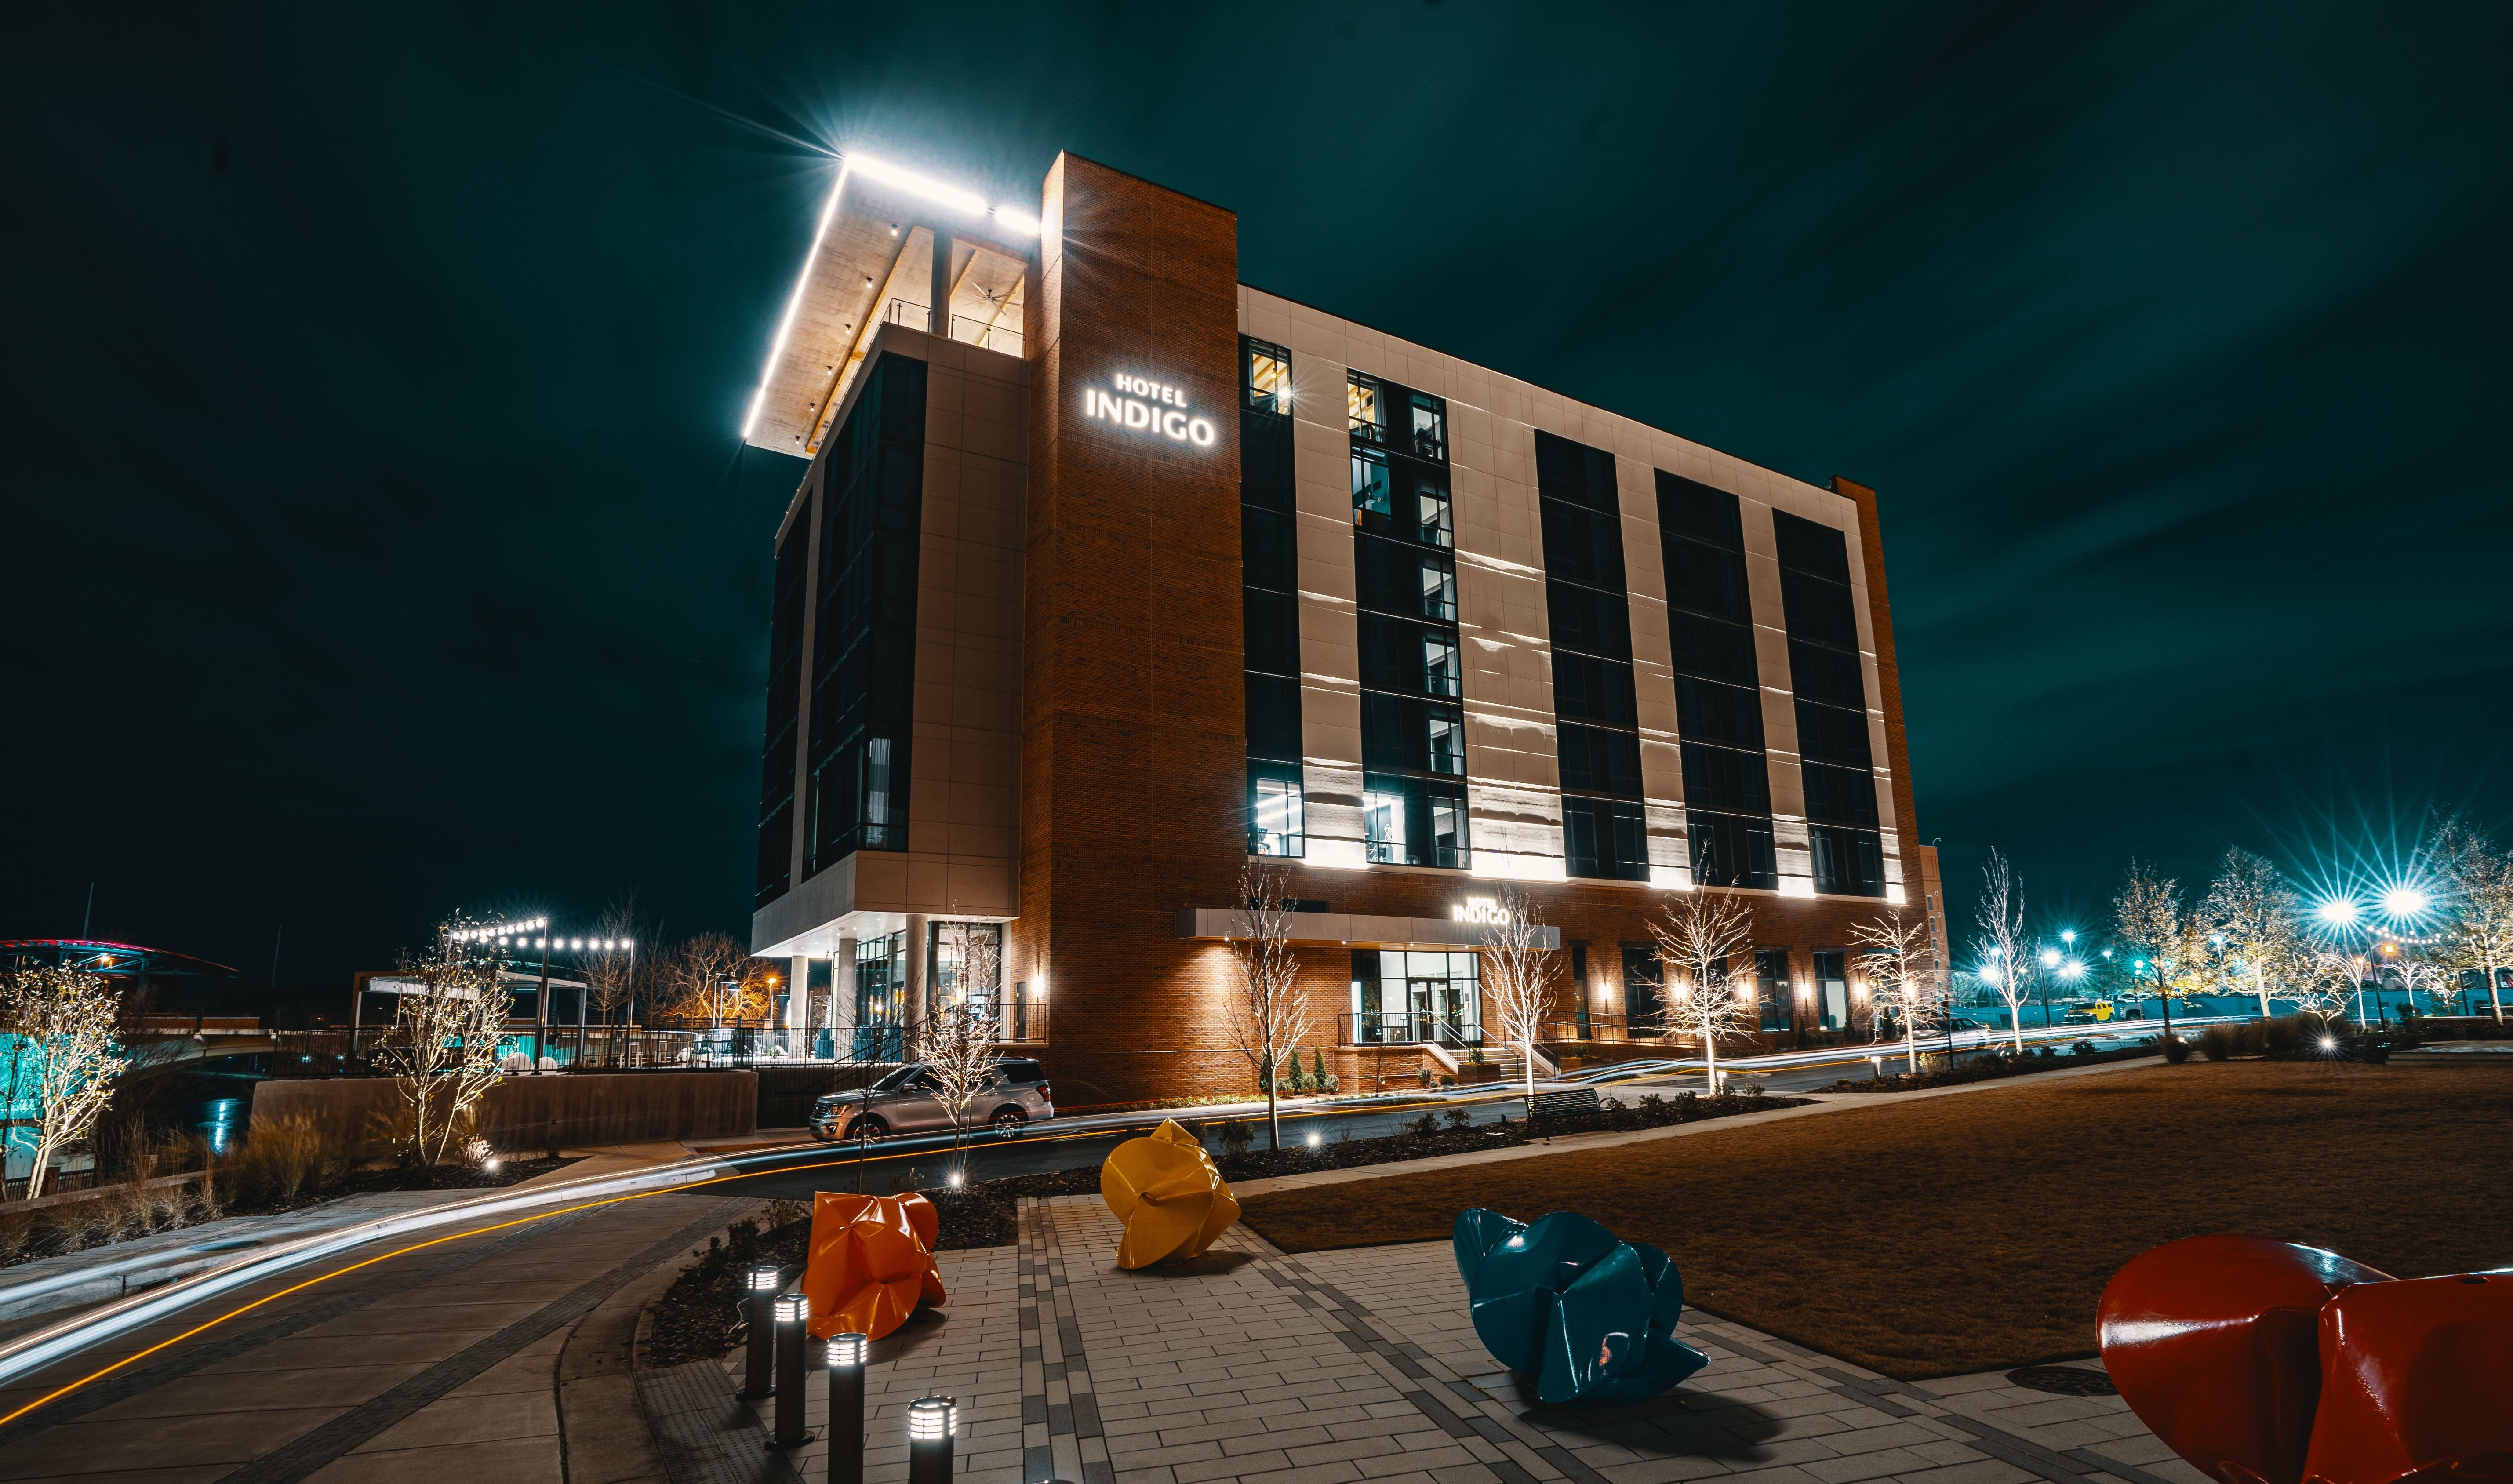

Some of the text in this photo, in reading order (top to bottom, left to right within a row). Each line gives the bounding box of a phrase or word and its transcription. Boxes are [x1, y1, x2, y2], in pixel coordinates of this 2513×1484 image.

[1116, 374, 1187, 407] HOTEL
[1087, 390, 1215, 446] INDIGO
[1454, 906, 1510, 924] INDIGO
